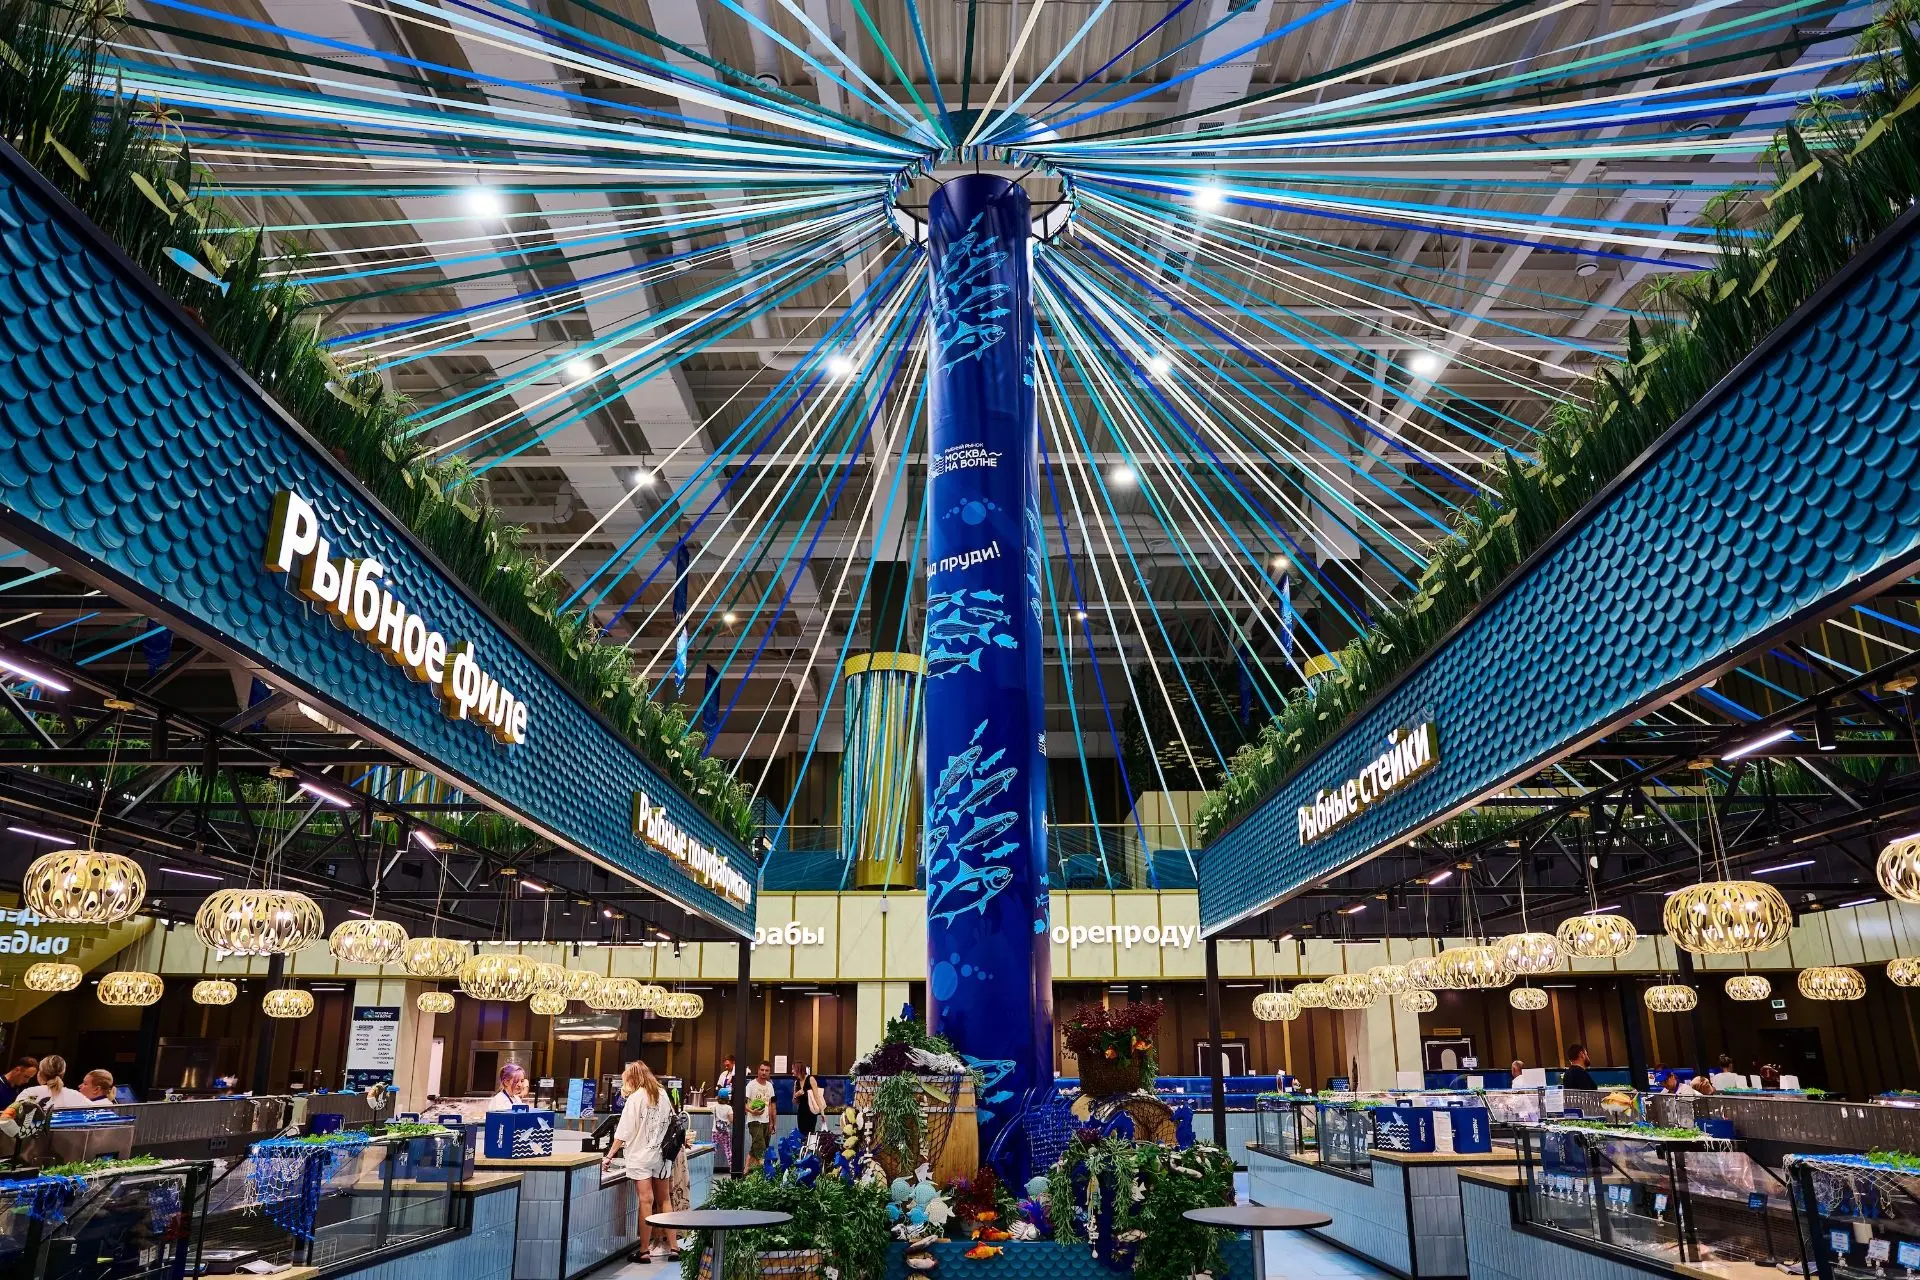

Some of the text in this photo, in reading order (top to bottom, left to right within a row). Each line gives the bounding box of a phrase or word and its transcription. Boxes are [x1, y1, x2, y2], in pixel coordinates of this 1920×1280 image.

[945, 449, 988, 463] МОСКВА
[945, 458, 997, 473] НА ВОЛНЕ
[940, 540, 1001, 572] пруди!
[278, 490, 527, 744] Рыбное филе
[1298, 722, 1431, 846] Рыбные стейки
[639, 791, 687, 861] Рыбные
